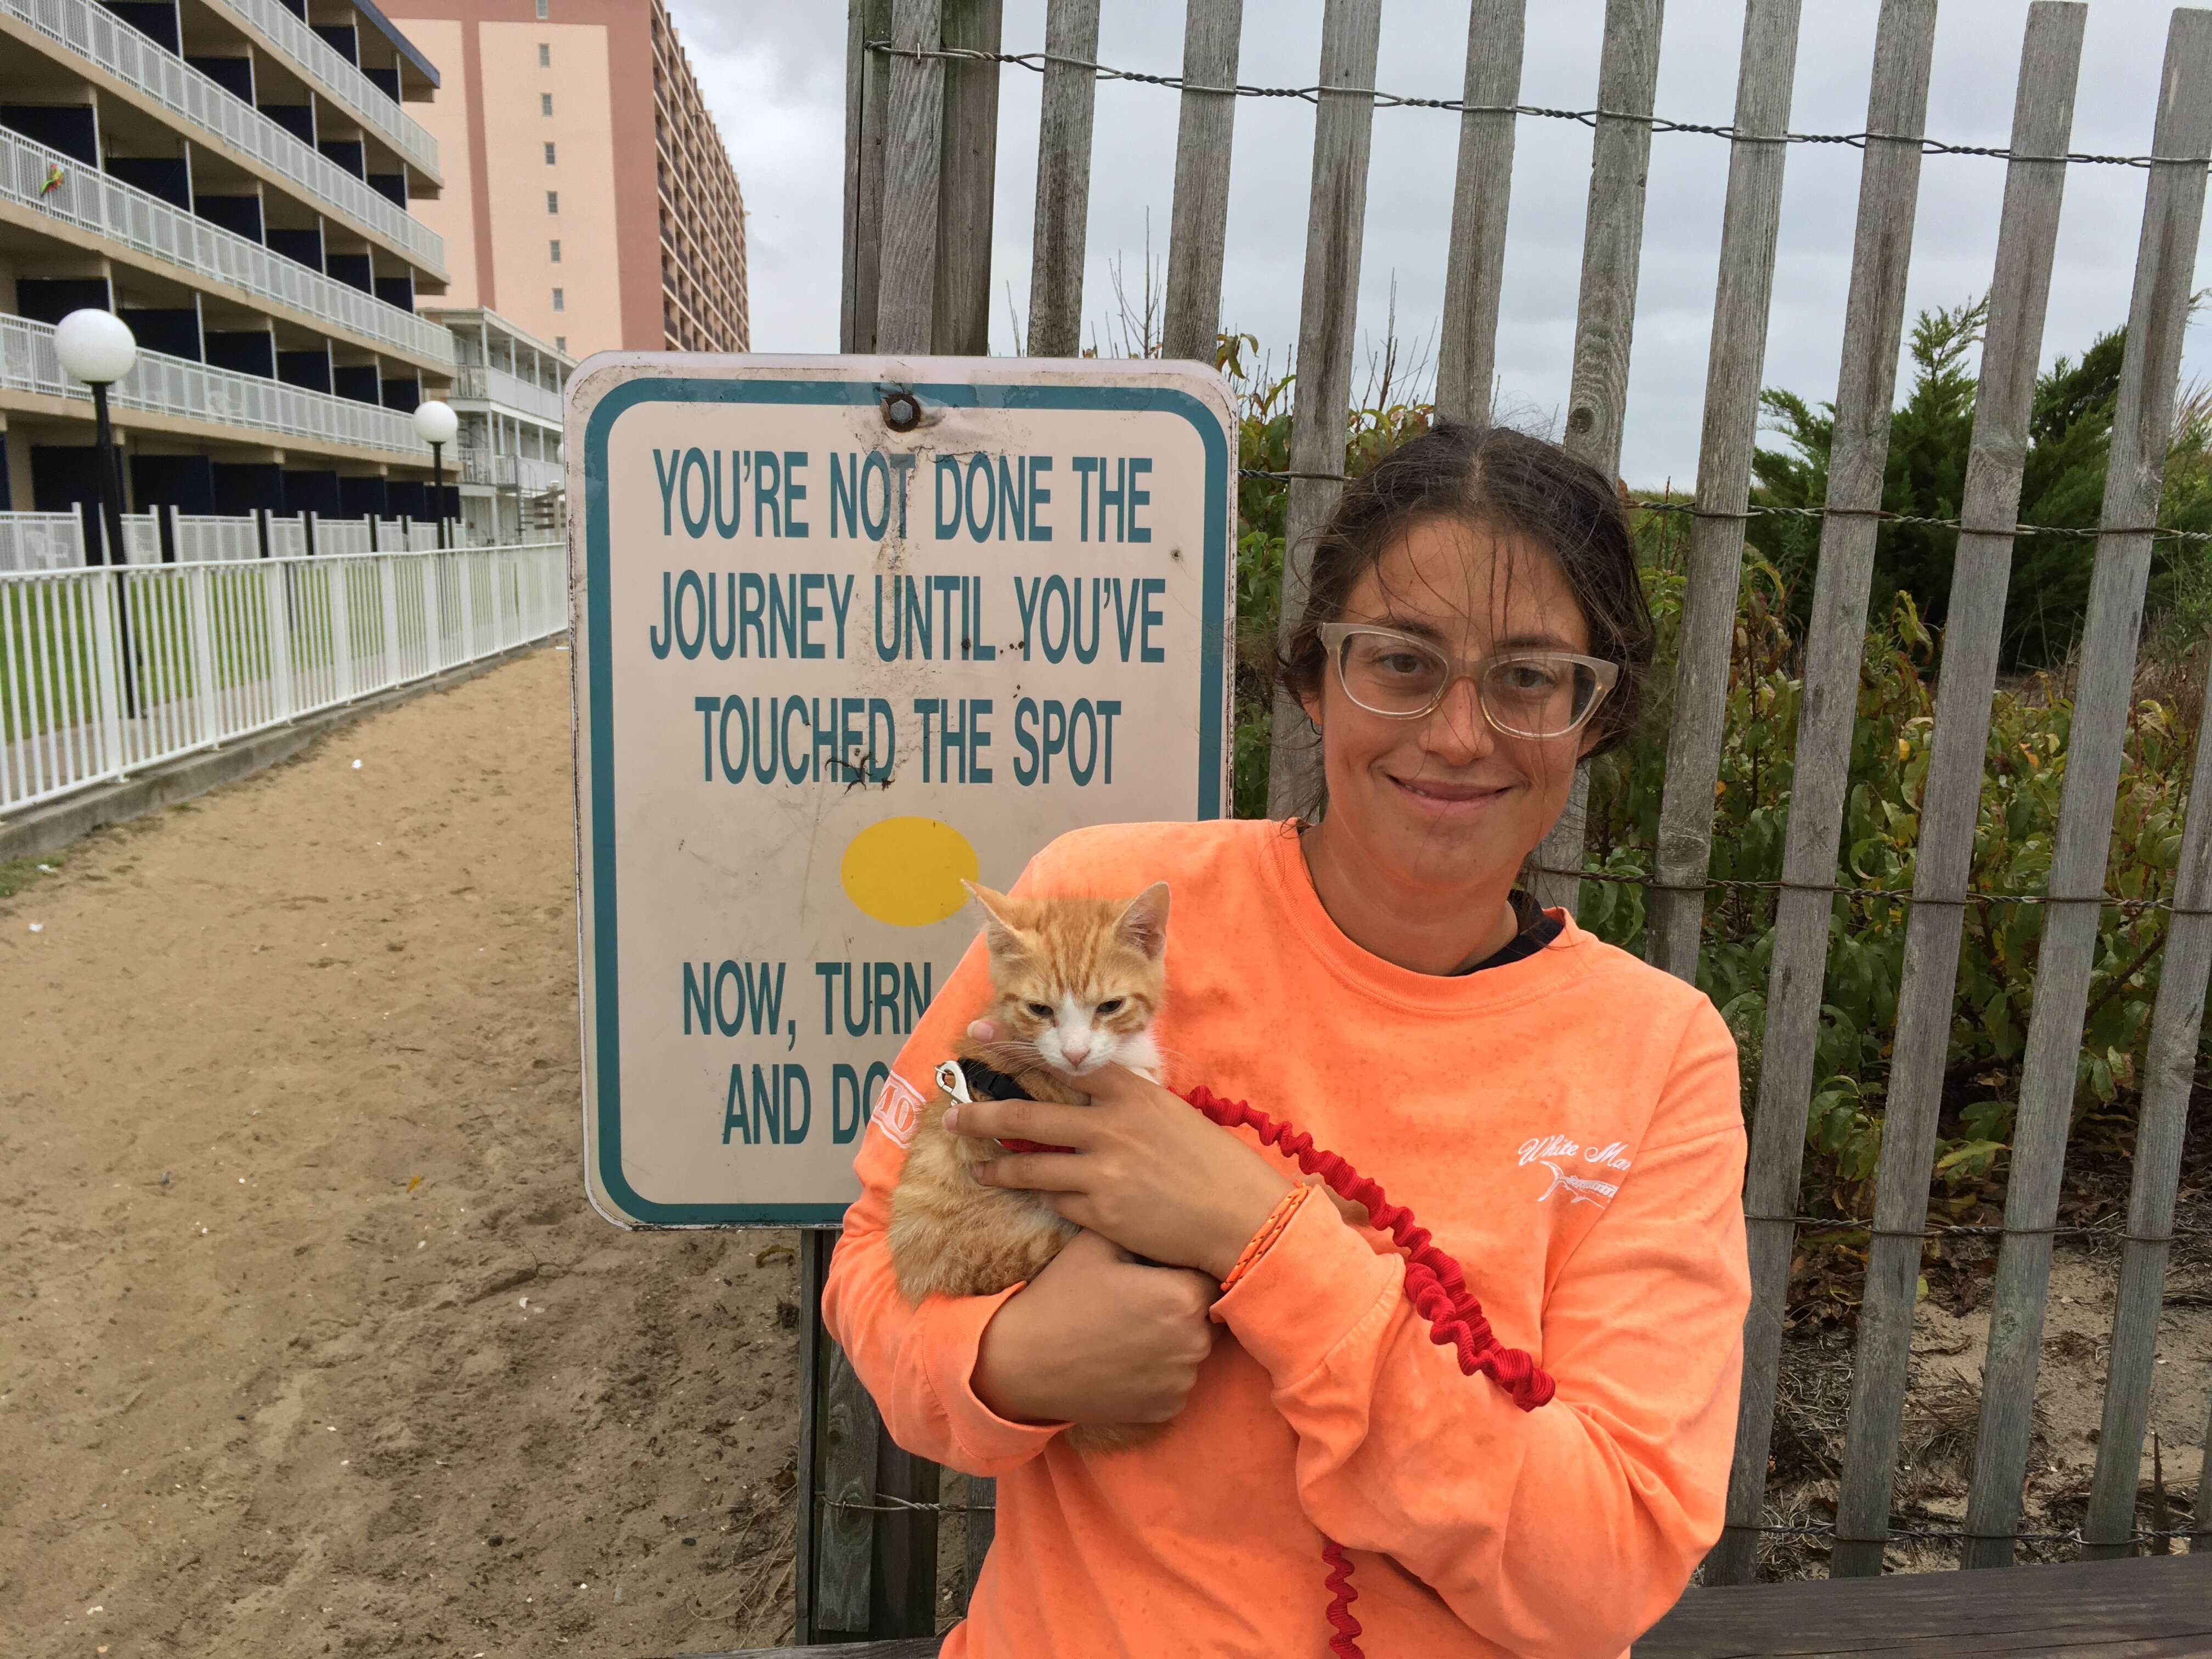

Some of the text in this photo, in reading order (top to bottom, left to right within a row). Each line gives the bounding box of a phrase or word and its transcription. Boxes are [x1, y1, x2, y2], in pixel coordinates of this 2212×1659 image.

[653, 447, 1153, 543] YOU'RE NOT DONE THE
[650, 569, 1166, 664] JOURNEY UNTIL YOU'VE
[695, 695, 1121, 786] TOUCHED THE SPOT
[683, 960, 932, 1051] NOW, TURN
[722, 1064, 810, 1144] AND
[1518, 1133, 1580, 1166] White
